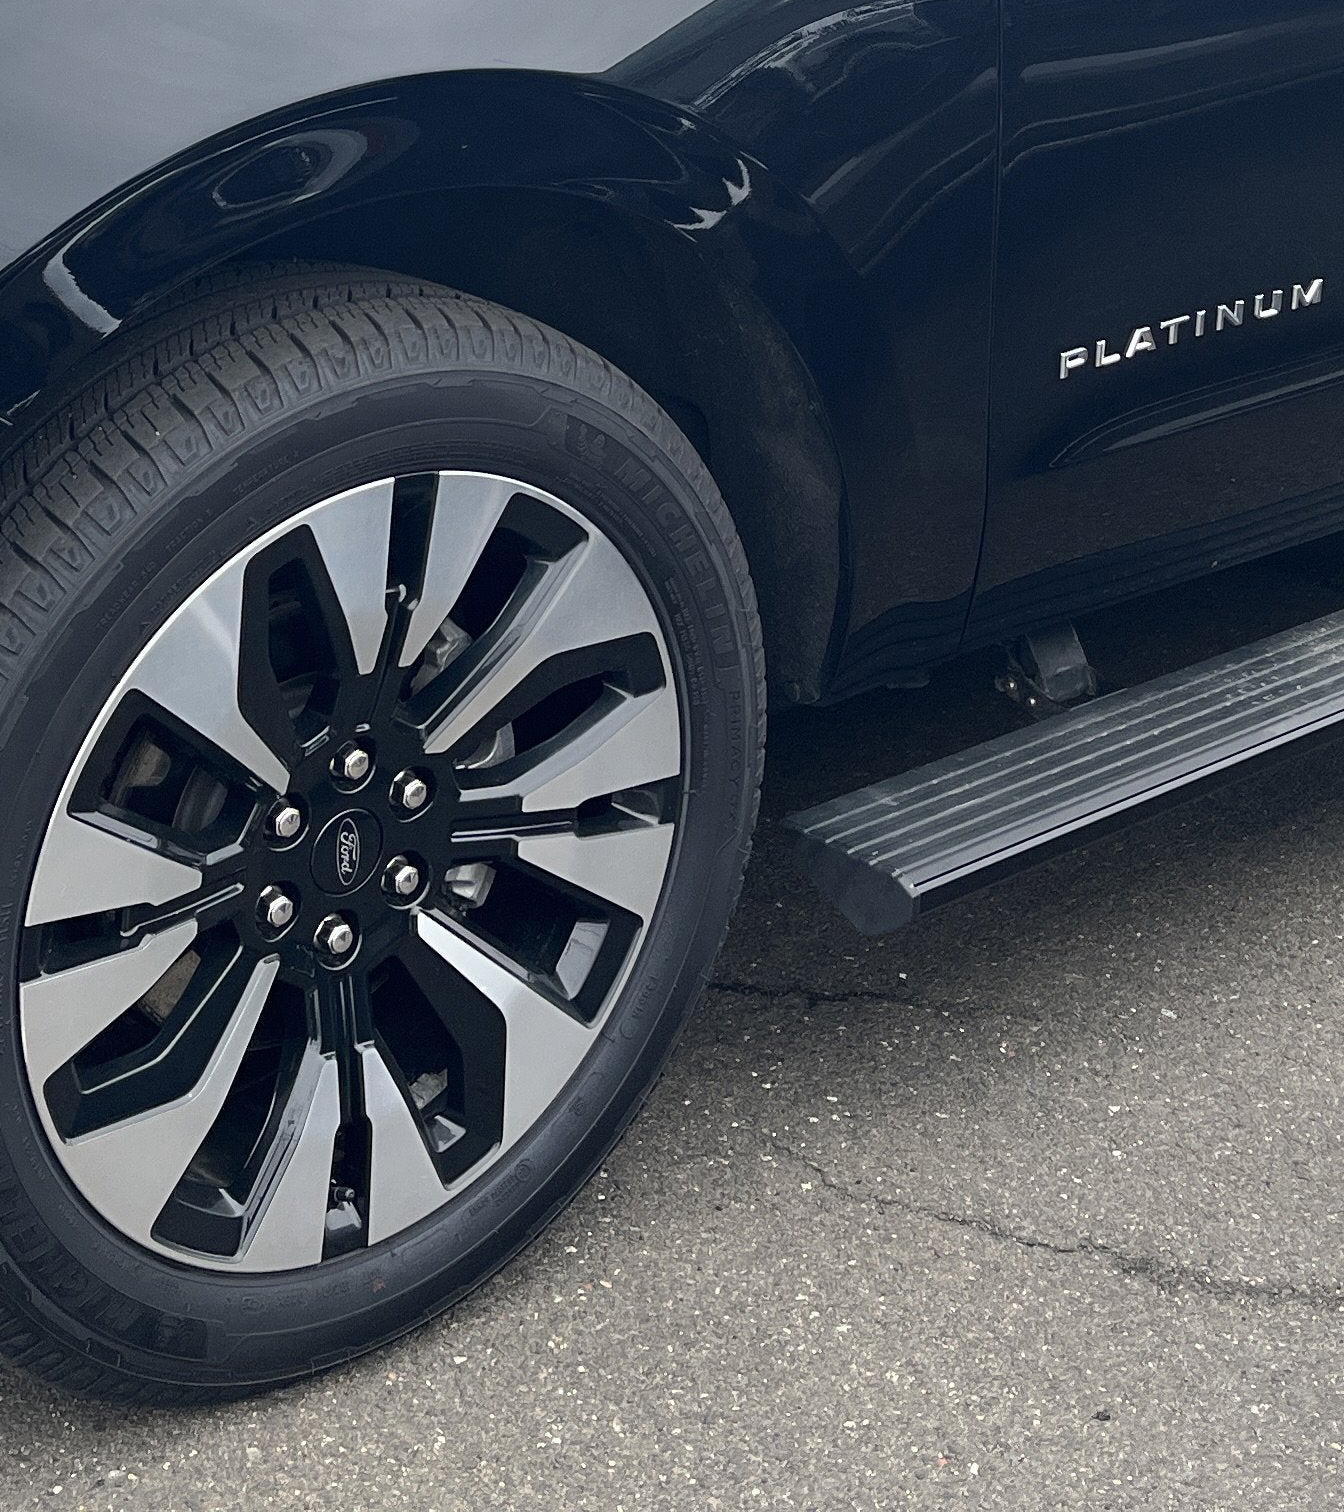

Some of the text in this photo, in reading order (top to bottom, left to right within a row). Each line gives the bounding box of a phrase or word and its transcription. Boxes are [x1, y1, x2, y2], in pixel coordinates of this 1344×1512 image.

[1059, 278, 1324, 380] PLATINUM
[613, 457, 736, 655] MICHELIN
[728, 690, 742, 787] PRIMACY
[339, 831, 357, 874] Ford
